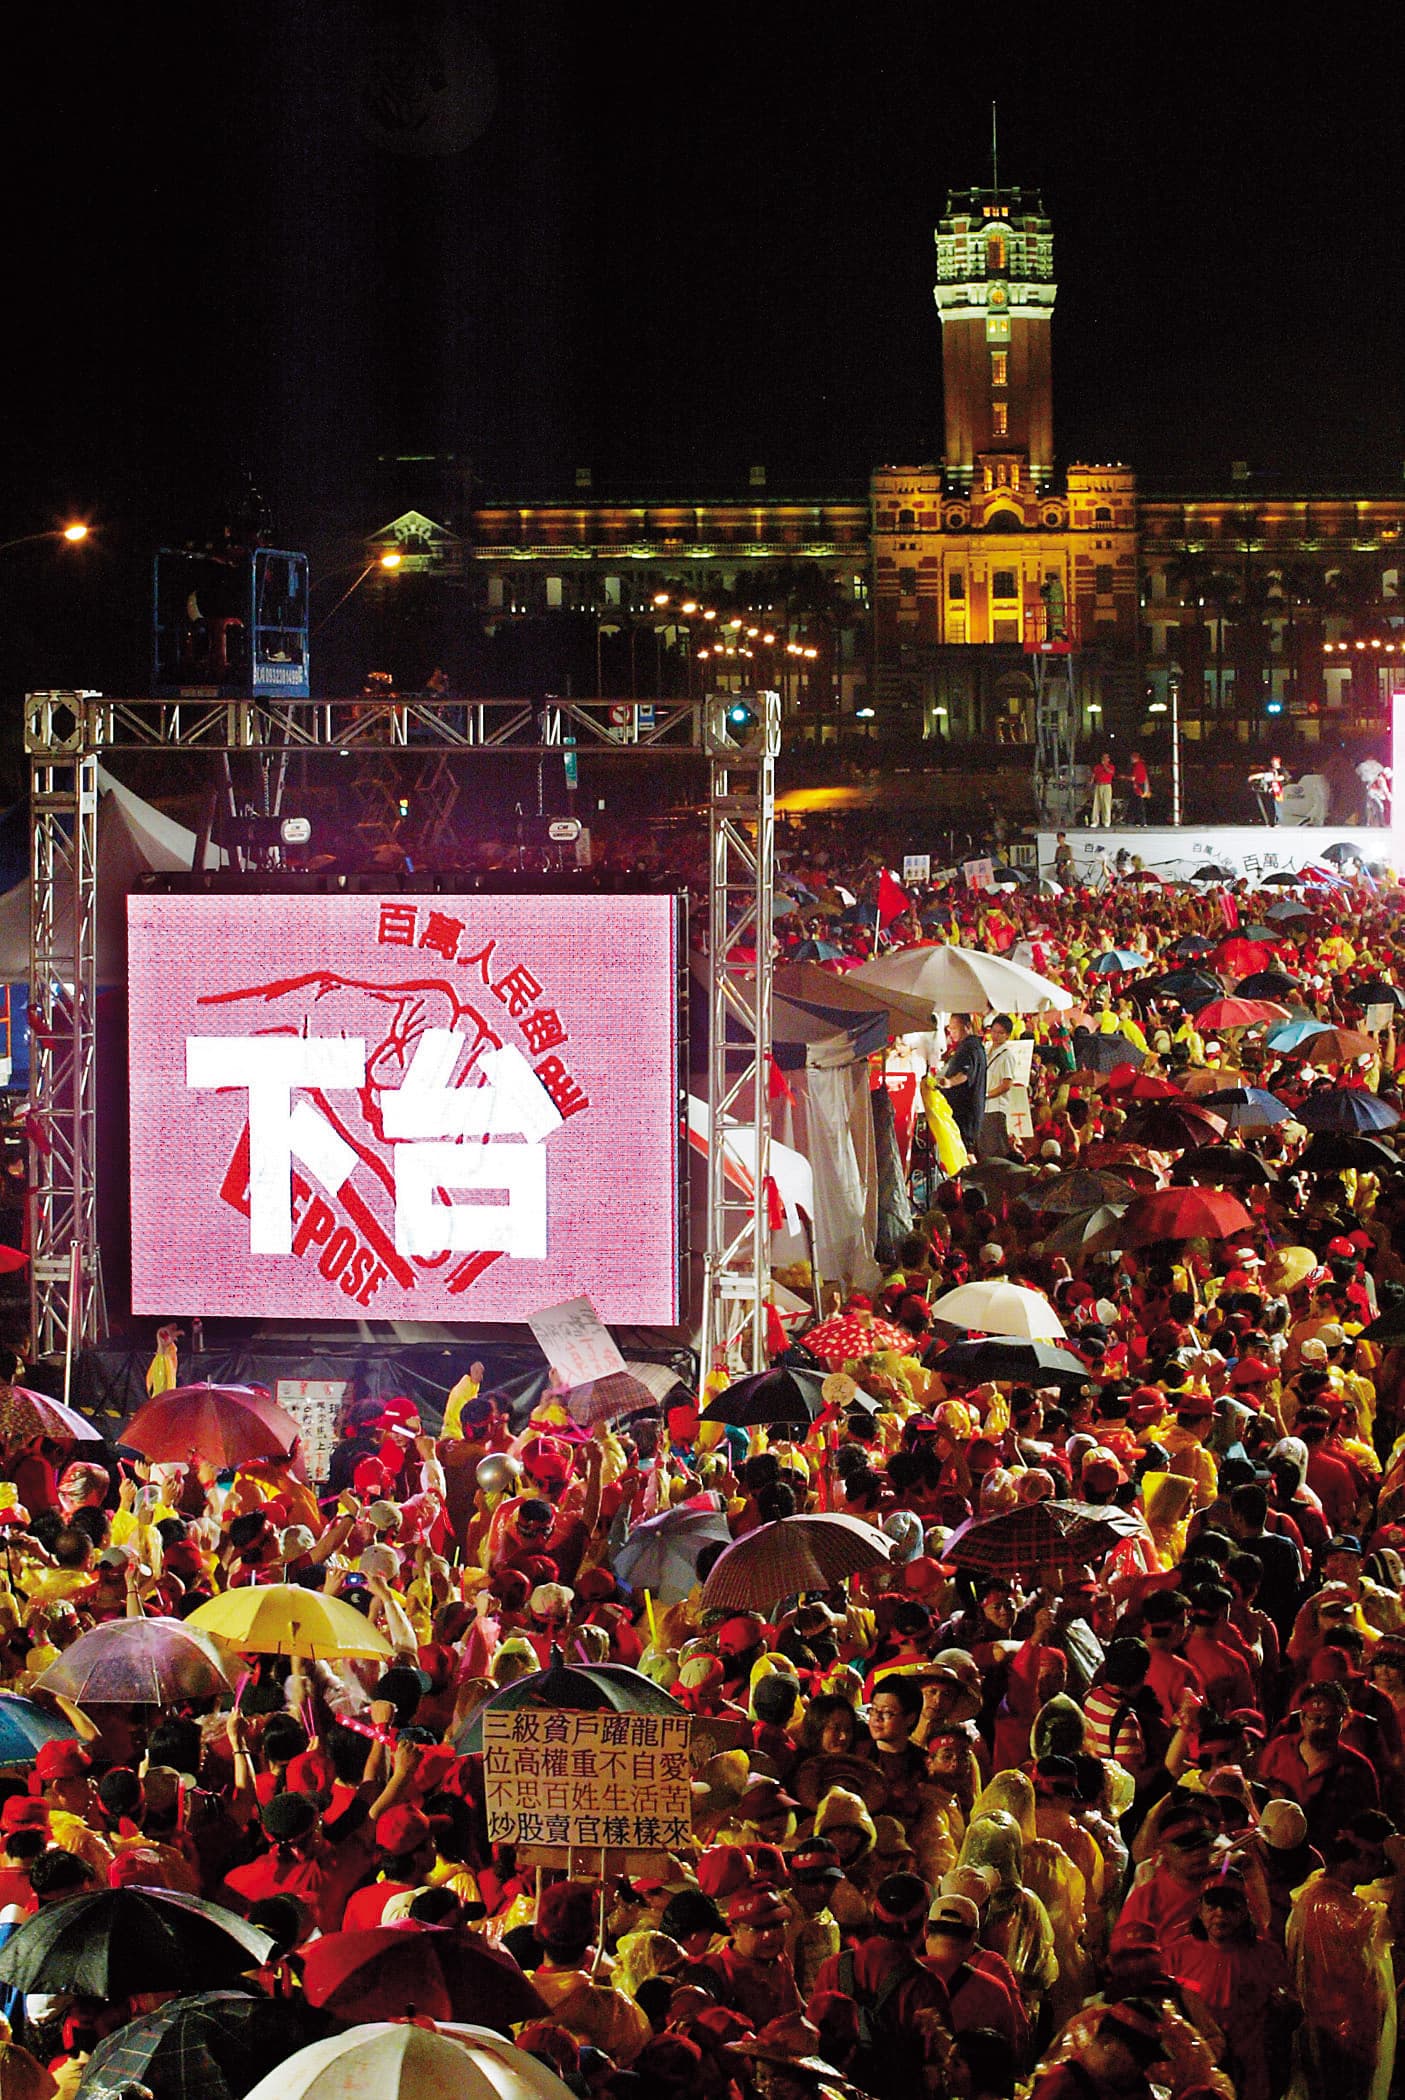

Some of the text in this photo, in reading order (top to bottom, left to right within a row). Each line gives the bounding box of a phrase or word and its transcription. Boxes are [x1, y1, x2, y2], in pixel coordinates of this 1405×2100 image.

[186, 1028, 564, 1259] 下台
[484, 1713, 688, 1749] 三級貧戶躍龍門
[484, 1746, 688, 1782] 位高權重不自愛
[487, 1779, 688, 1814] 不思百姓生活苦
[489, 1812, 691, 1846] 炒股賣官樣樣來
